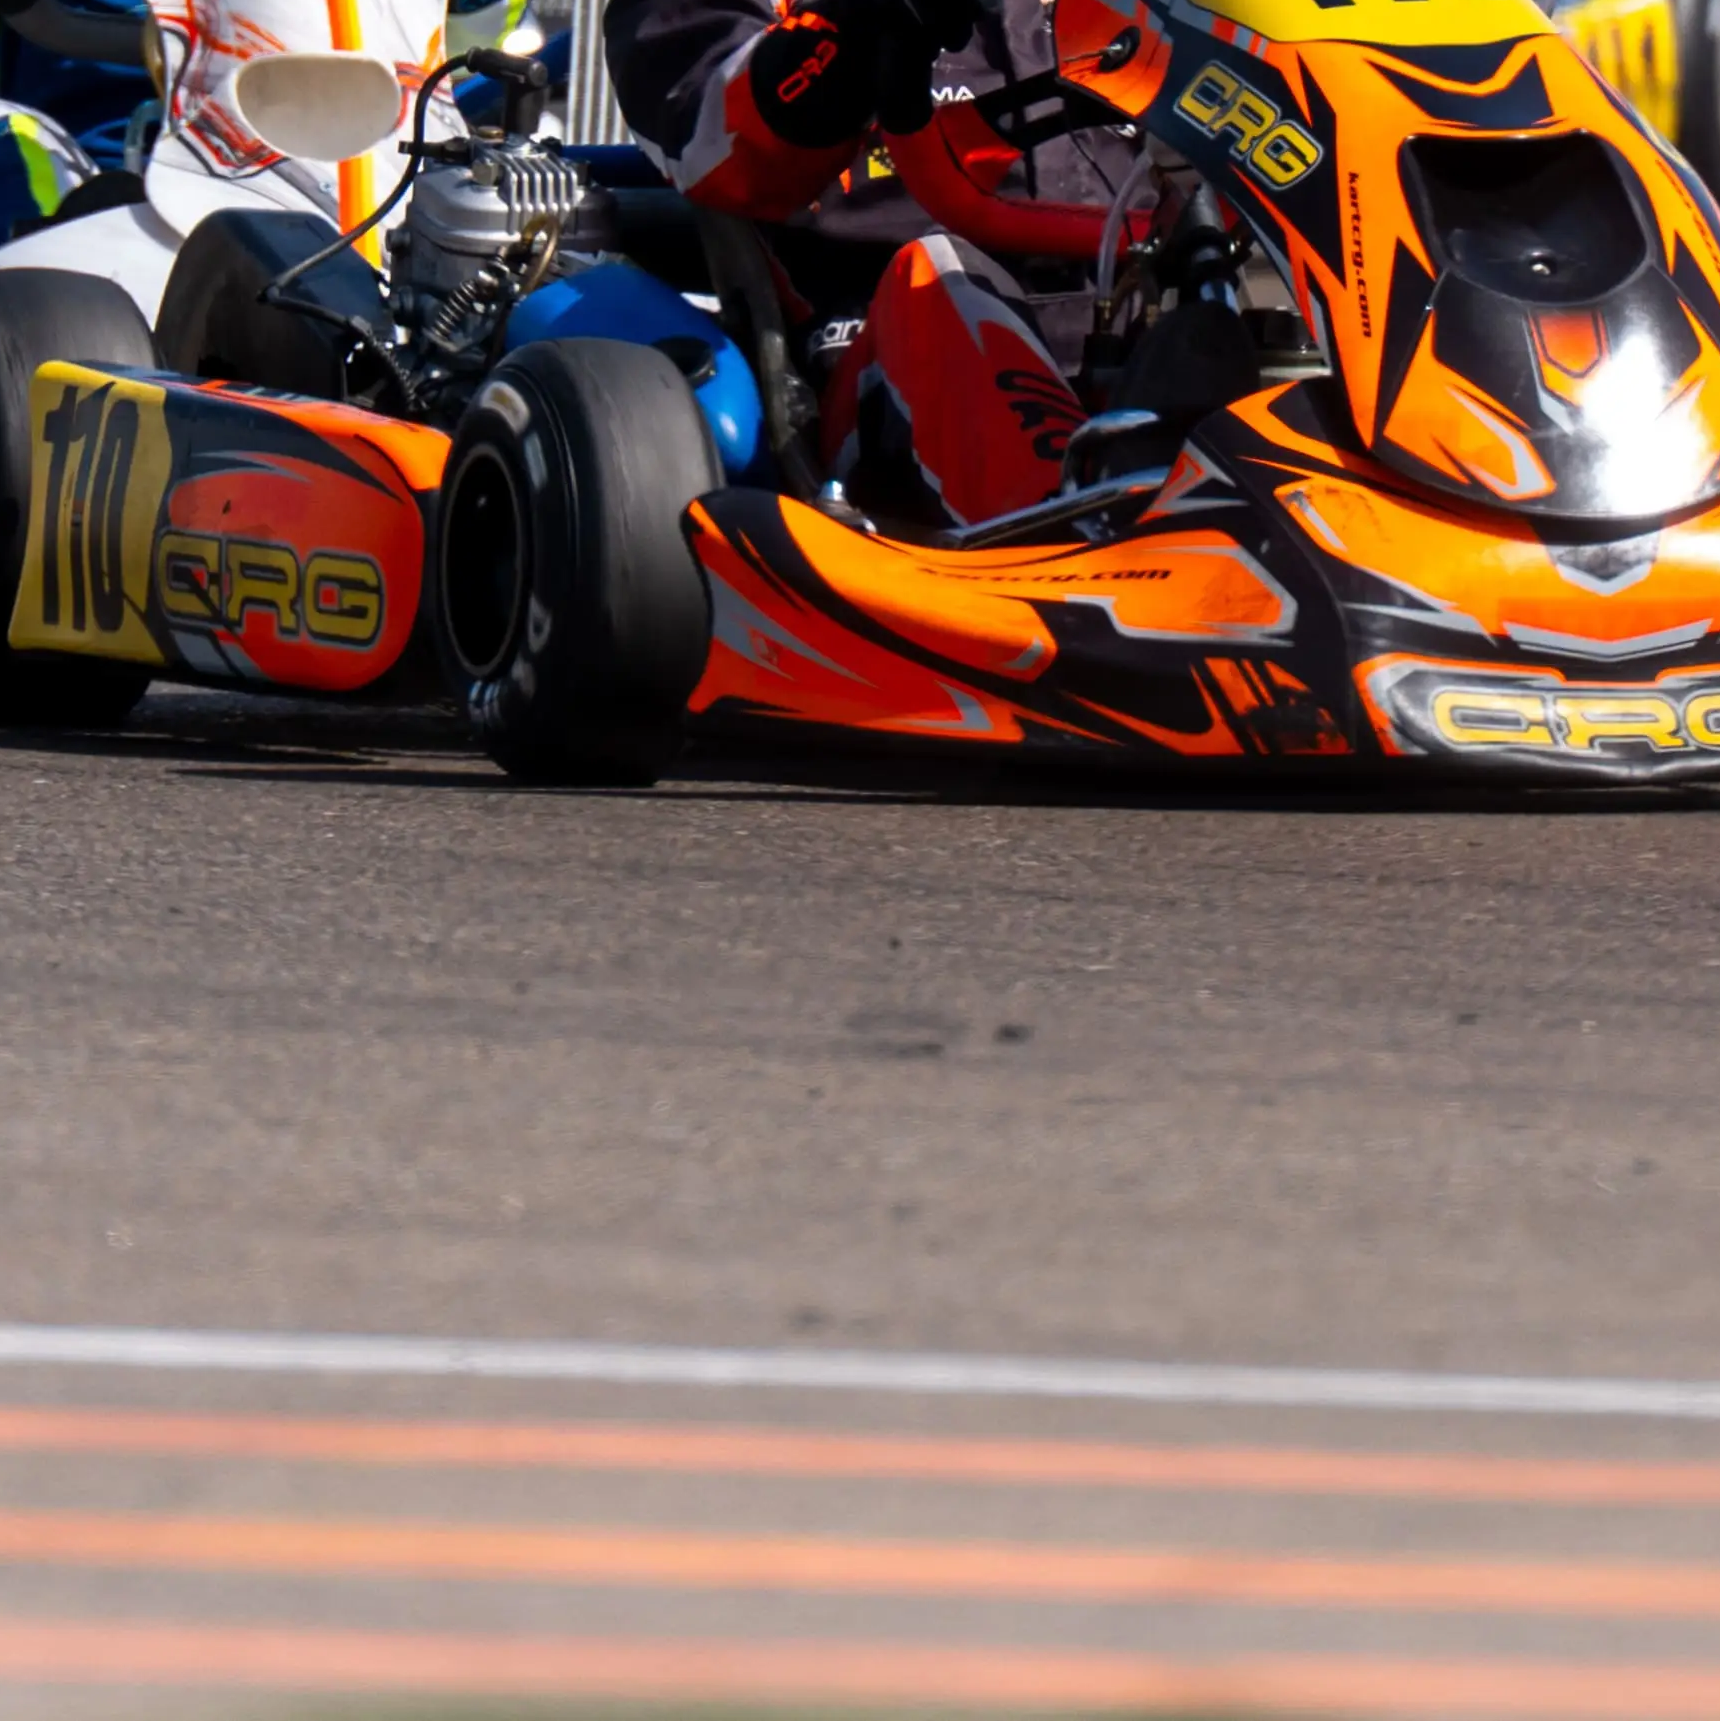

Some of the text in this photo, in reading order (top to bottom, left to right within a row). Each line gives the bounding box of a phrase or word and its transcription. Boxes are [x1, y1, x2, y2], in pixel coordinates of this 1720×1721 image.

[1175, 60, 1324, 190] CRG
[1348, 171, 1372, 338] kartcrg.com
[42, 381, 141, 634] 110
[156, 528, 383, 650] CRG
